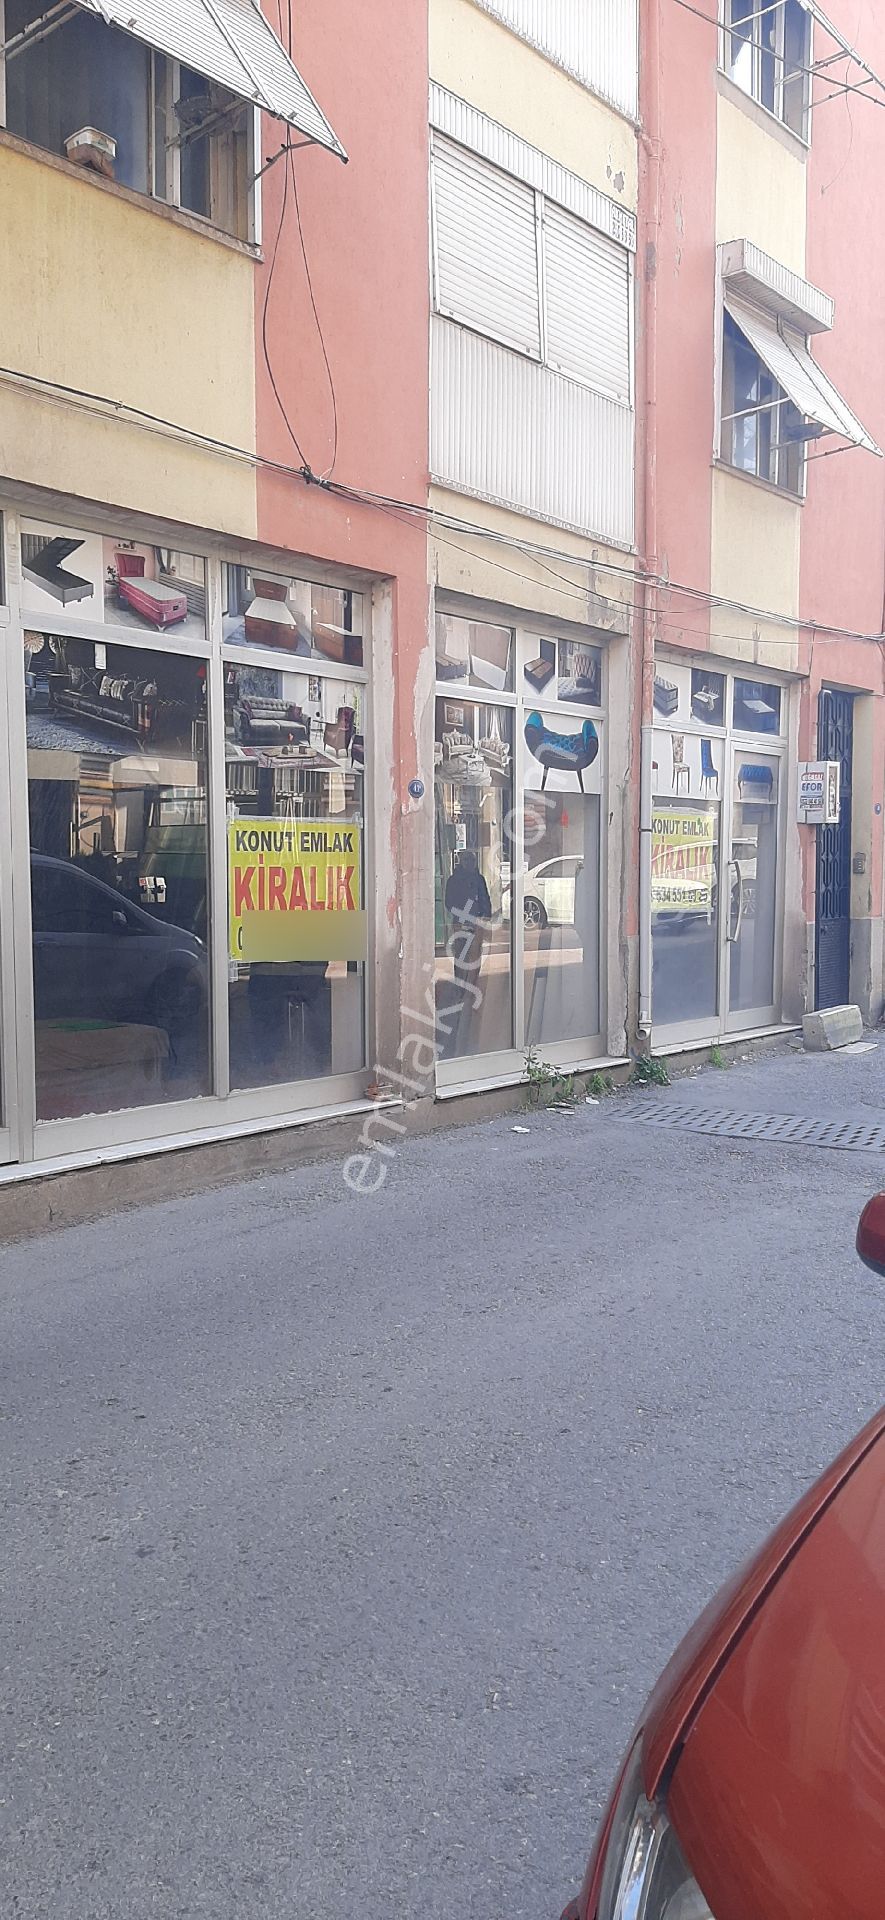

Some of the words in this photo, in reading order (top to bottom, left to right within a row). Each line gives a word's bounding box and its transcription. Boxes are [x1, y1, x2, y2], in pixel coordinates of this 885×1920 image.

[652, 818, 680, 835] KONUT
[682, 820, 709, 837] EMLAK
[235, 830, 295, 852] KONUT
[300, 831, 353, 853] EMLAK
[233, 853, 356, 917] KİRALIK
